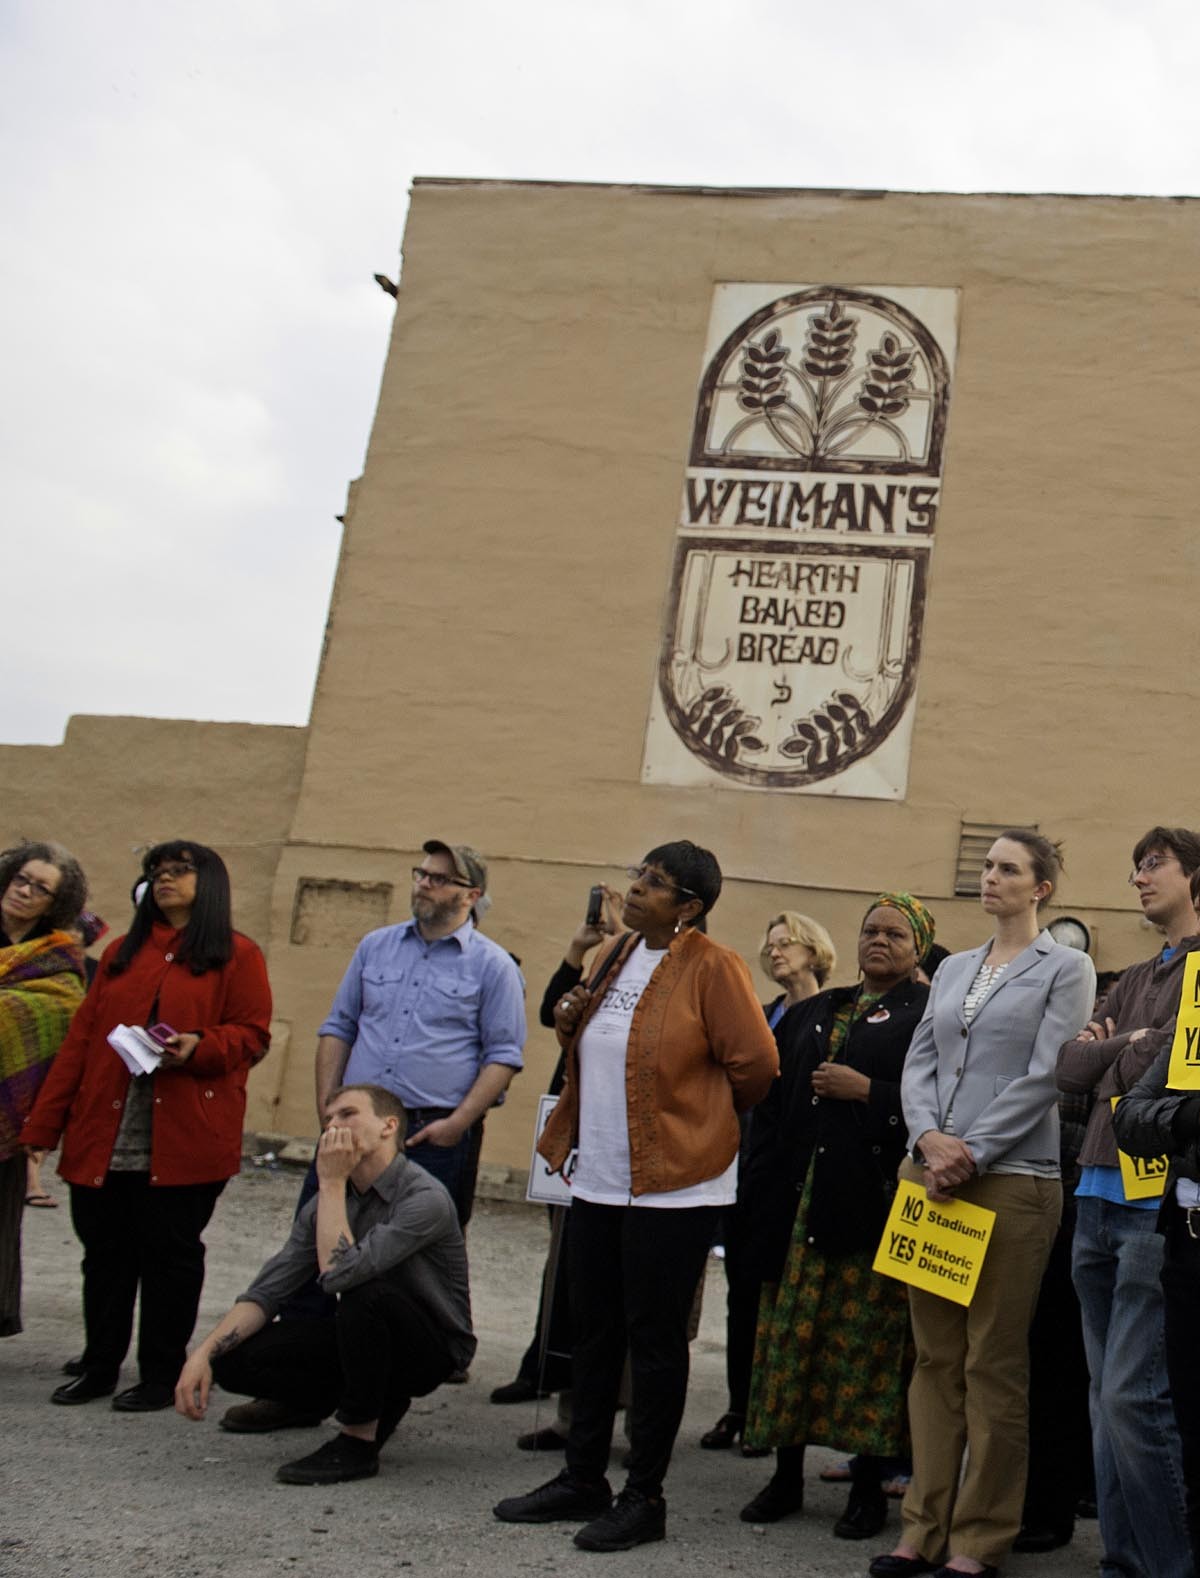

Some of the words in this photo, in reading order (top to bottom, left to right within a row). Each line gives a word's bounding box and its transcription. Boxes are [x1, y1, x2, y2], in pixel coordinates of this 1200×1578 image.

[685, 478, 939, 535] WEIMAN'S
[728, 560, 860, 594] HEARTH
[739, 596, 846, 629] BAKED
[736, 633, 839, 665] BREAD
[901, 1195, 924, 1223] NO
[927, 1210, 987, 1242] Stadium!
[888, 1231, 917, 1262] YES
[922, 1241, 974, 1271] Historic
[918, 1256, 970, 1286] District!
